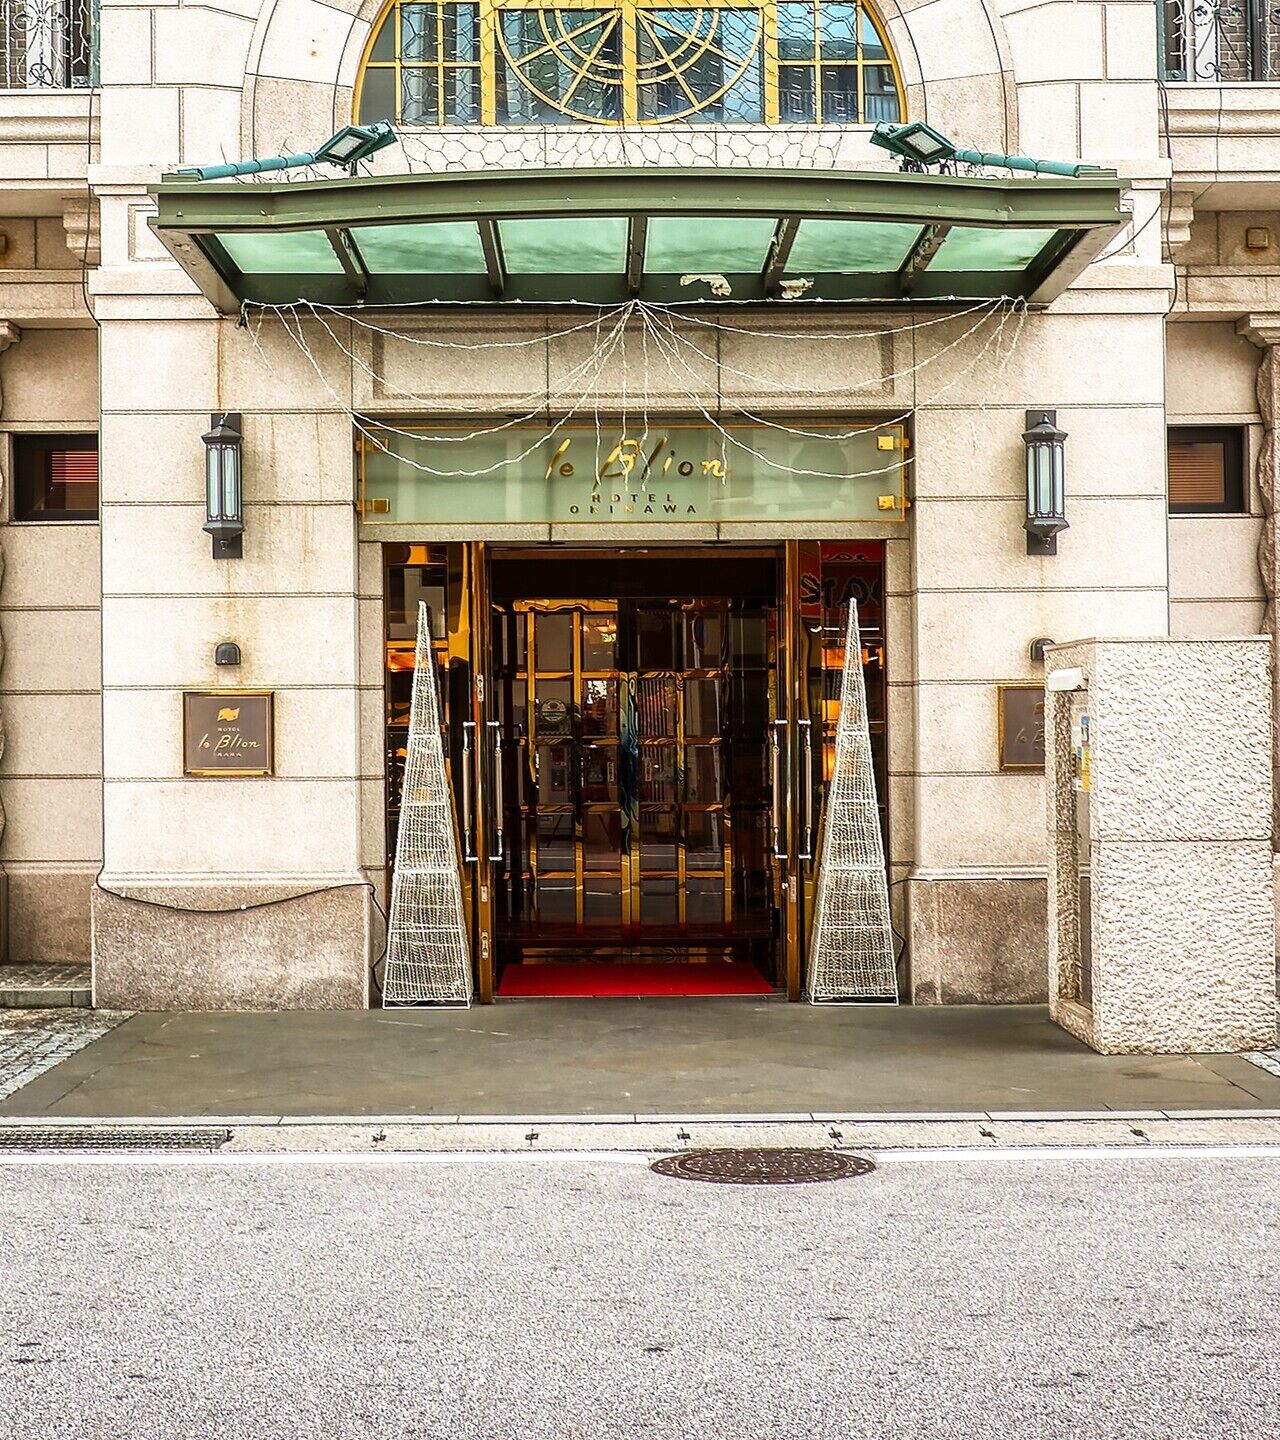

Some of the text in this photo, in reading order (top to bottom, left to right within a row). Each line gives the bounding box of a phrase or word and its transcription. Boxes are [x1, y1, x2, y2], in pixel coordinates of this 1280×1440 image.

[545, 436, 733, 492] le Blion
[592, 493, 673, 503] HOTEL
[570, 504, 697, 514] OKINAWA
[214, 733, 261, 752] Blion
